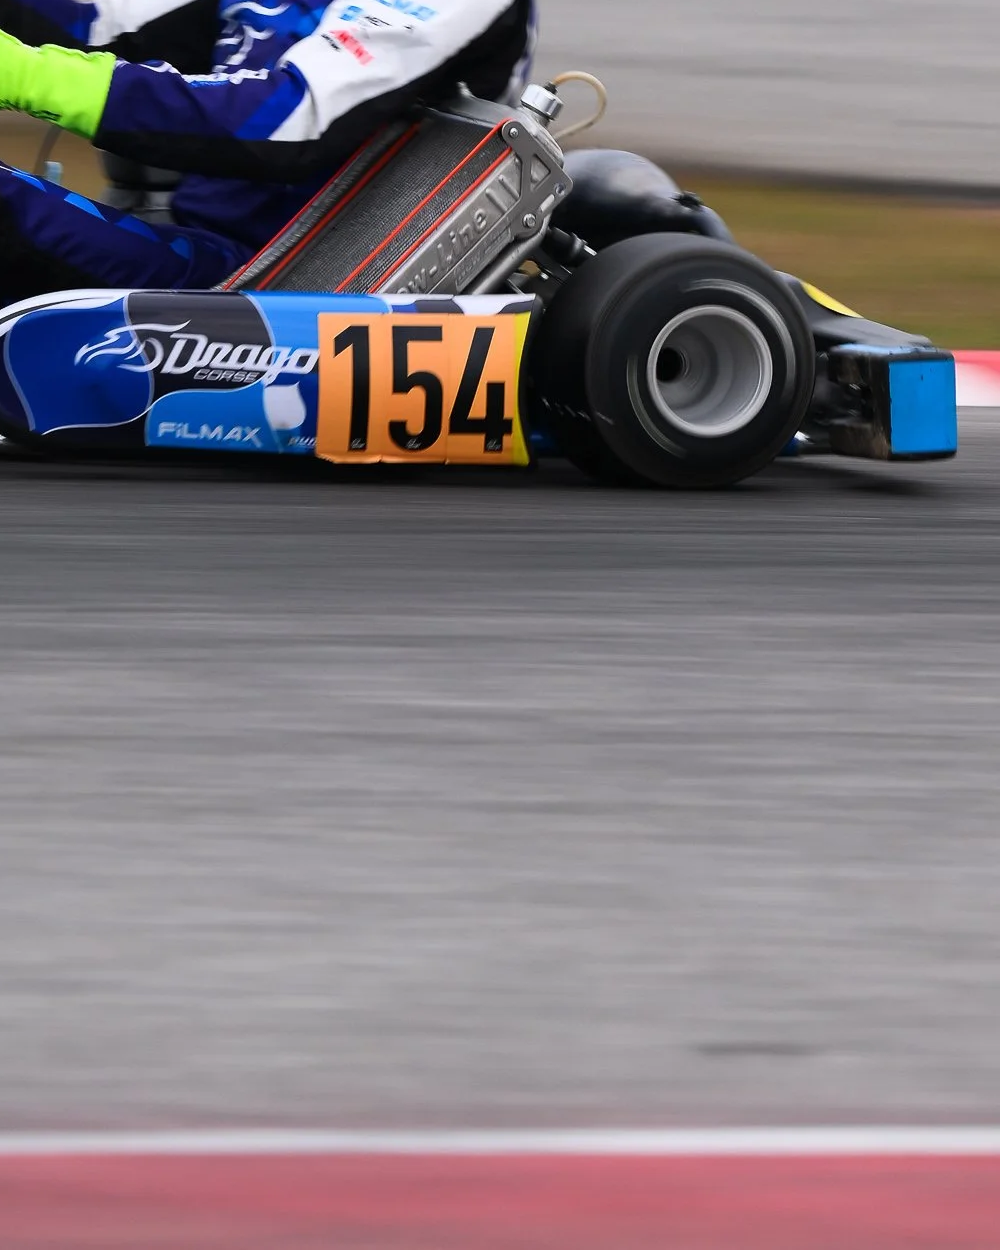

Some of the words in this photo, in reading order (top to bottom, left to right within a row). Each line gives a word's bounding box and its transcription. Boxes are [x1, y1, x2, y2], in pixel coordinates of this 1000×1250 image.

[161, 333, 320, 389] Drago
[193, 368, 261, 383] CORSE
[333, 325, 513, 454] 154
